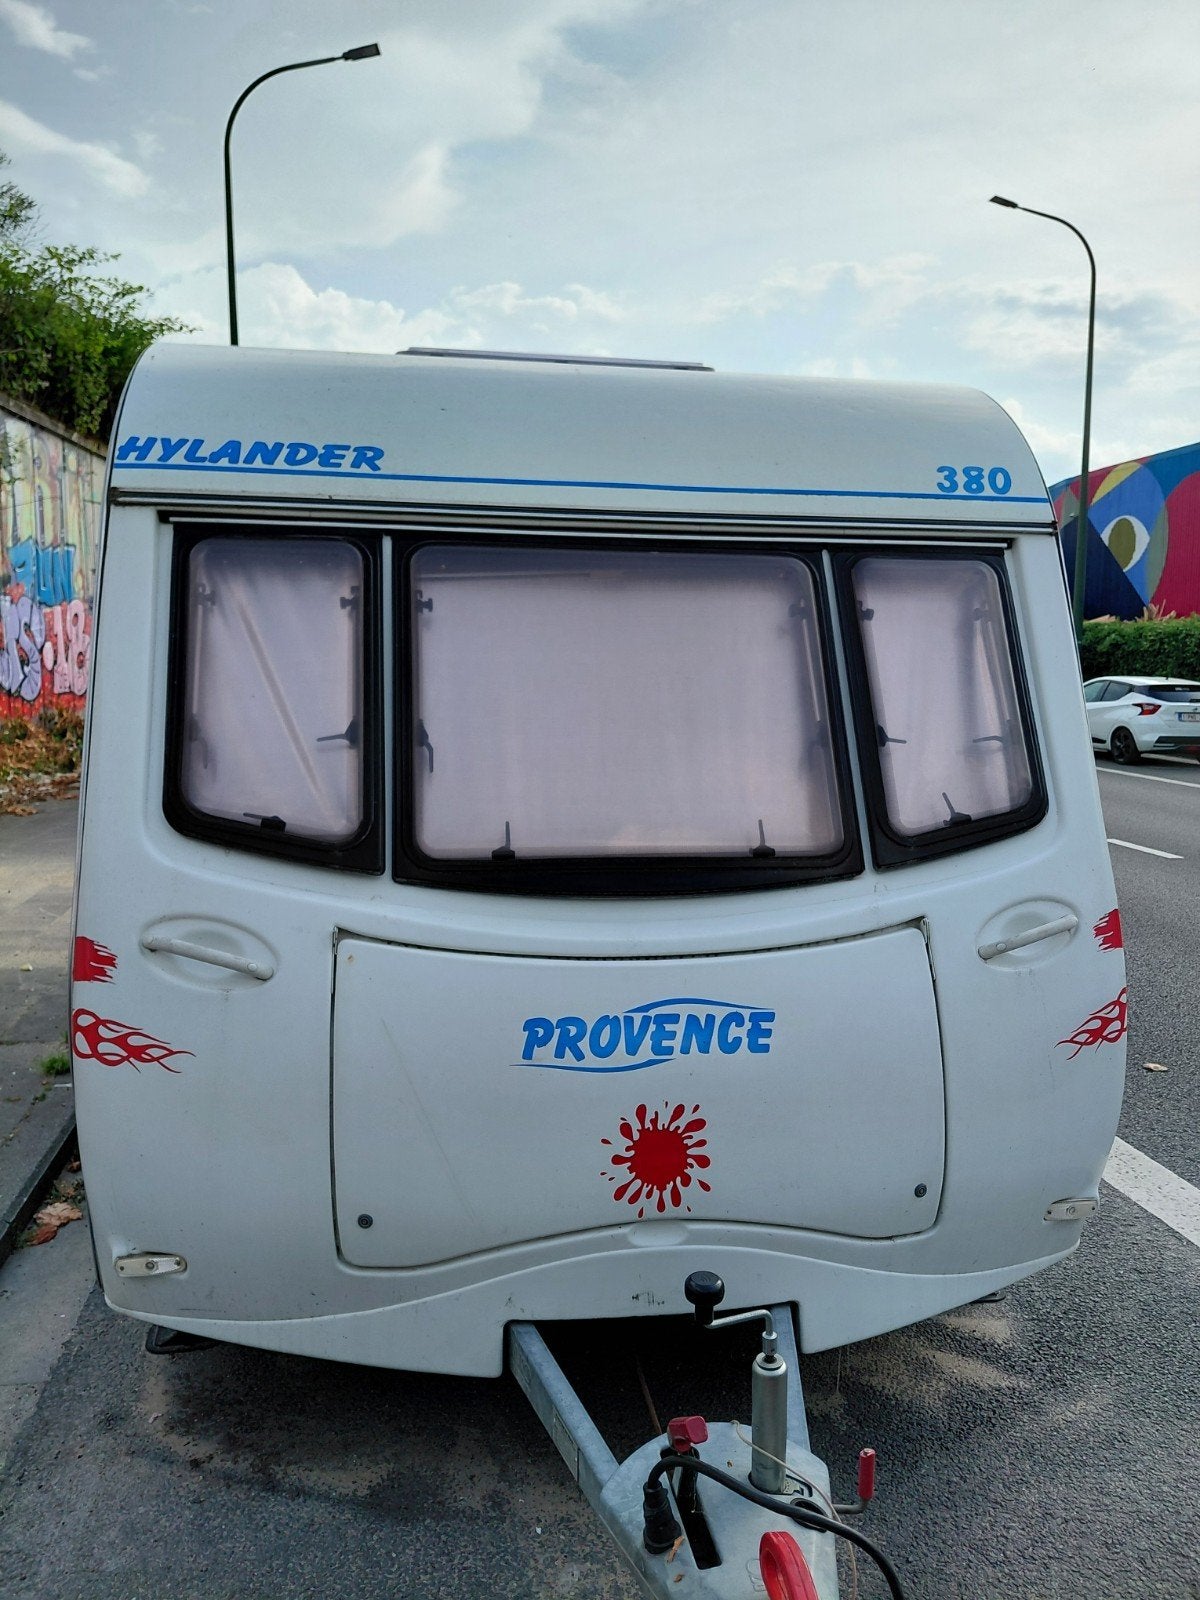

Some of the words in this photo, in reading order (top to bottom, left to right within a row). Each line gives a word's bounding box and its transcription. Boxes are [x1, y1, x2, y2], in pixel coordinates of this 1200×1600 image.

[116, 436, 385, 471] HYLANDER
[936, 465, 1012, 495] 380
[521, 1011, 776, 1063] PROVENCE
